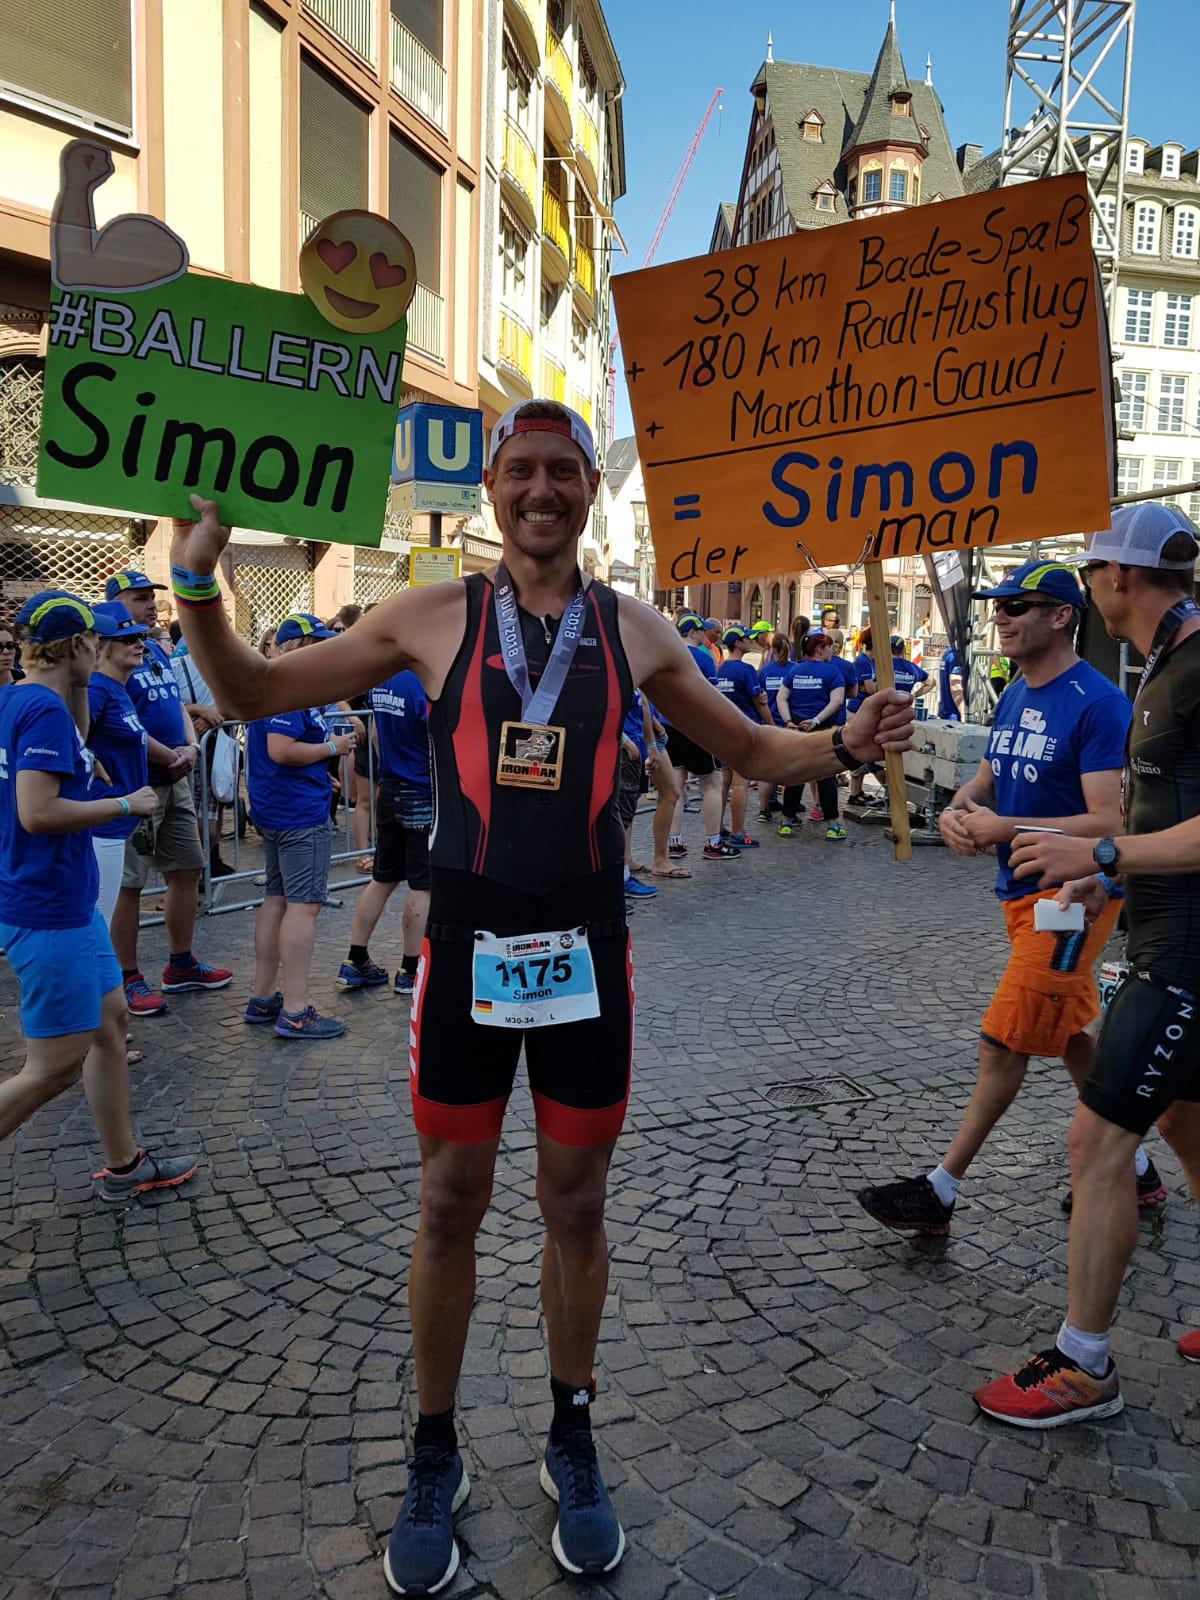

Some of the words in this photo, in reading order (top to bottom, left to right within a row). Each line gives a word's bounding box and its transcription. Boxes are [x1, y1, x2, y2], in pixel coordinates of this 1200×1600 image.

[693, 263, 760, 328] 3,8
[775, 257, 827, 309] km
[855, 194, 1087, 292] Bade-Spaß
[50, 293, 400, 405] #BALLERN
[662, 332, 746, 391] 180
[756, 326, 821, 377] km
[837, 264, 1089, 360] Radl-Ausflug
[730, 332, 1067, 442] Marathon-Gaudi
[44, 361, 354, 514] Simon
[428, 418, 471, 472] U
[762, 440, 1039, 528] Simon
[671, 538, 749, 582] der
[873, 503, 1000, 558] man
[499, 585, 509, 595] 8
[500, 595, 517, 623] JULY
[504, 626, 519, 657] 2018
[565, 611, 581, 639] 2018
[500, 760, 556, 778] IRONMAN
[1042, 737, 1058, 762] 2018
[512, 939, 551, 952] IRONMAN
[496, 954, 573, 989] 1175
[512, 988, 553, 1000] Simon
[1135, 1002, 1194, 1098] RYZON
